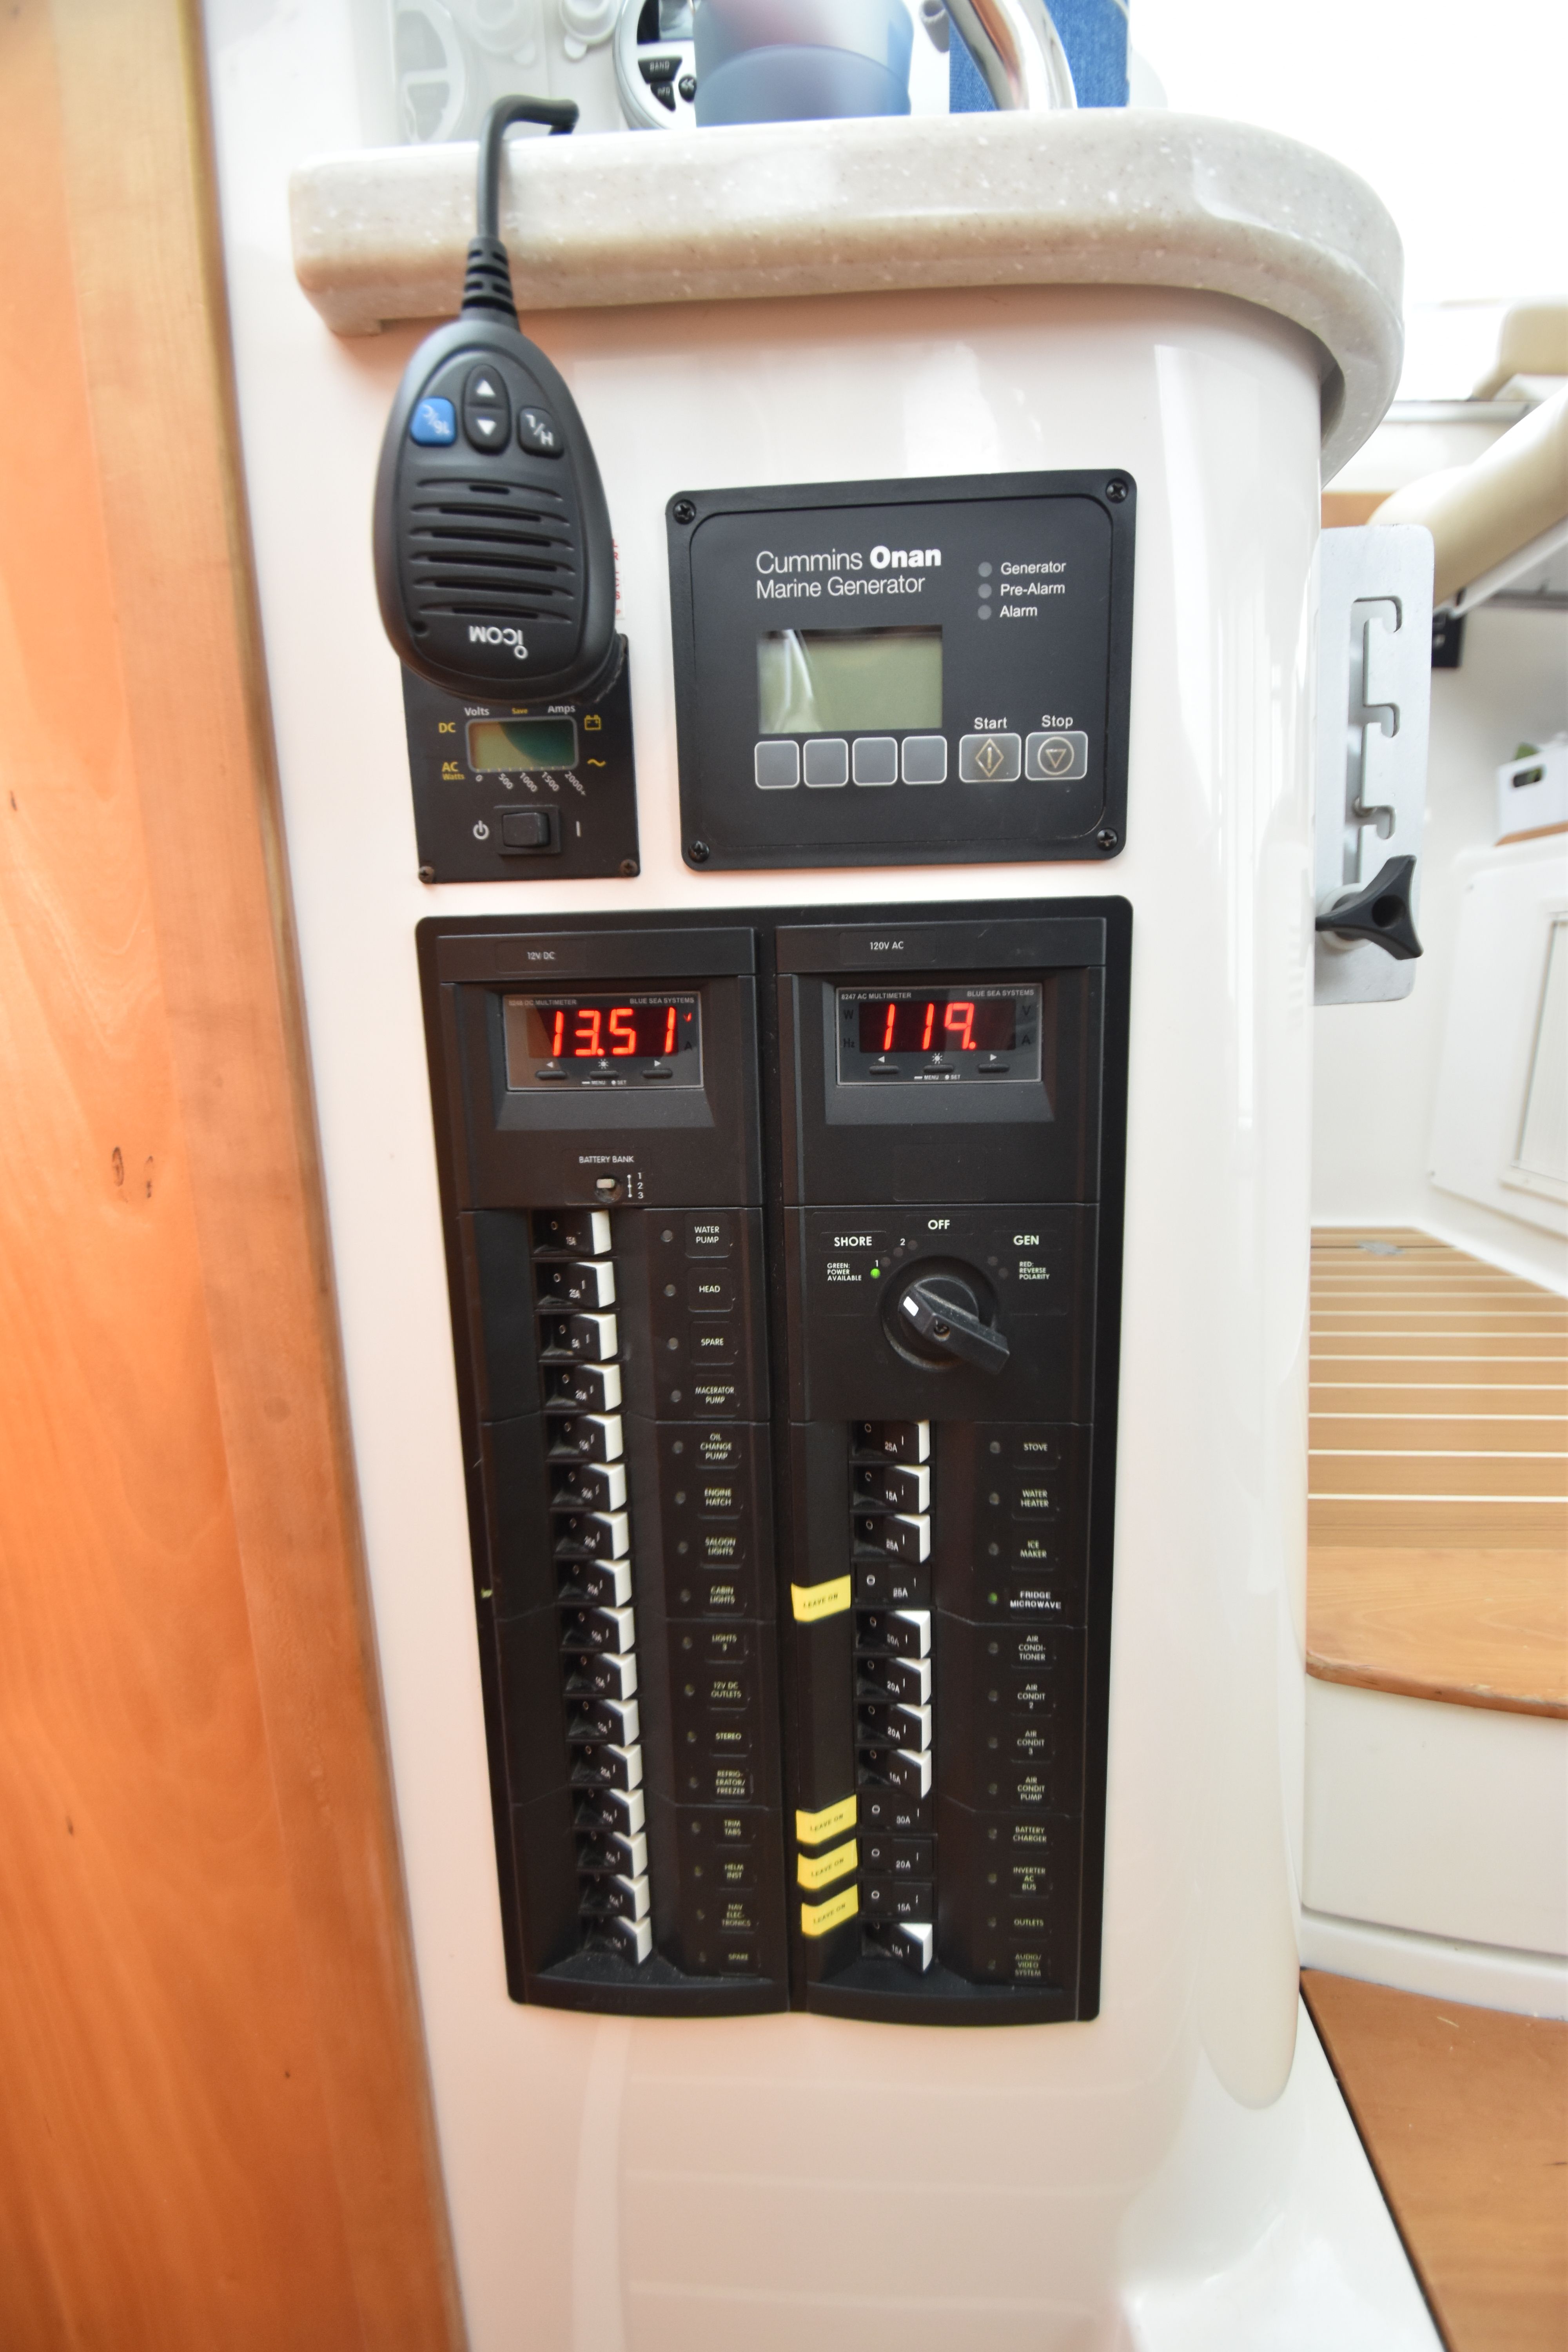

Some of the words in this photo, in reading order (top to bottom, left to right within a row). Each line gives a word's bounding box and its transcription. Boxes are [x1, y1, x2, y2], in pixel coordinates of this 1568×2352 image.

[650, 60, 670, 72] BAND
[525, 413, 554, 446] H/L
[756, 548, 863, 574] Cummins
[869, 545, 941, 569] Onan
[1000, 561, 1067, 575] Generator
[756, 578, 822, 599] Marine
[827, 575, 926, 596] Generator
[1000, 582, 1065, 596] Pre-Alarm
[1000, 605, 1038, 617] Alarm
[464, 707, 490, 716] Volts
[548, 705, 576, 715] Amps
[974, 717, 1008, 730] Start
[1041, 715, 1074, 730] Stop
[439, 722, 456, 733] DC
[442, 762, 458, 772] AC
[442, 772, 465, 780] Watts
[499, 773, 514, 789] 500
[520, 772, 537, 792] 1000
[542, 771, 559, 792] 1500
[869, 942, 890, 950] 120V
[892, 941, 904, 949] AC
[527, 951, 541, 960] 12V
[543, 951, 555, 960] DC
[552, 1006, 676, 1057] 13.51
[927, 1219, 951, 1230] OFF
[834, 1236, 873, 1247] SHORE
[1013, 1235, 1040, 1246] GEN
[701, 1338, 724, 1346] SPARE
[695, 1386, 735, 1395] MACERATOR
[705, 1396, 725, 1404] PUMP
[710, 1433, 722, 1441] OIL
[700, 1442, 732, 1451] CHANGE
[1024, 1443, 1048, 1451] STOVE
[705, 1452, 728, 1460] PUMP
[704, 1488, 732, 1497] ENGINE
[1022, 1489, 1048, 1497] WATER
[706, 1497, 731, 1506] HATCH
[1021, 1498, 1049, 1507] HEATER
[1027, 1540, 1039, 1548] ICE
[708, 1547, 734, 1556] LIGHTS
[1020, 1549, 1047, 1558] MAKER
[1020, 1590, 1051, 1599] FRIDGE
[1010, 1600, 1062, 1609] MICROWAVE
[1019, 1653, 1045, 1661] TIONER
[711, 1690, 742, 1699] OUTLETS
[715, 1732, 742, 1740] STEREO
[1017, 1739, 1045, 1747] CONDIT
[810, 1820, 833, 1832] LEAVE
[834, 1813, 844, 1822] ON
[1015, 1826, 1045, 1834] BATTERY
[811, 1865, 833, 1877] LEAVE
[834, 1857, 844, 1866] ON
[813, 1910, 835, 1924] LEAVE
[836, 1903, 846, 1912] ON
[1014, 1918, 1044, 1927] OUTLETS
